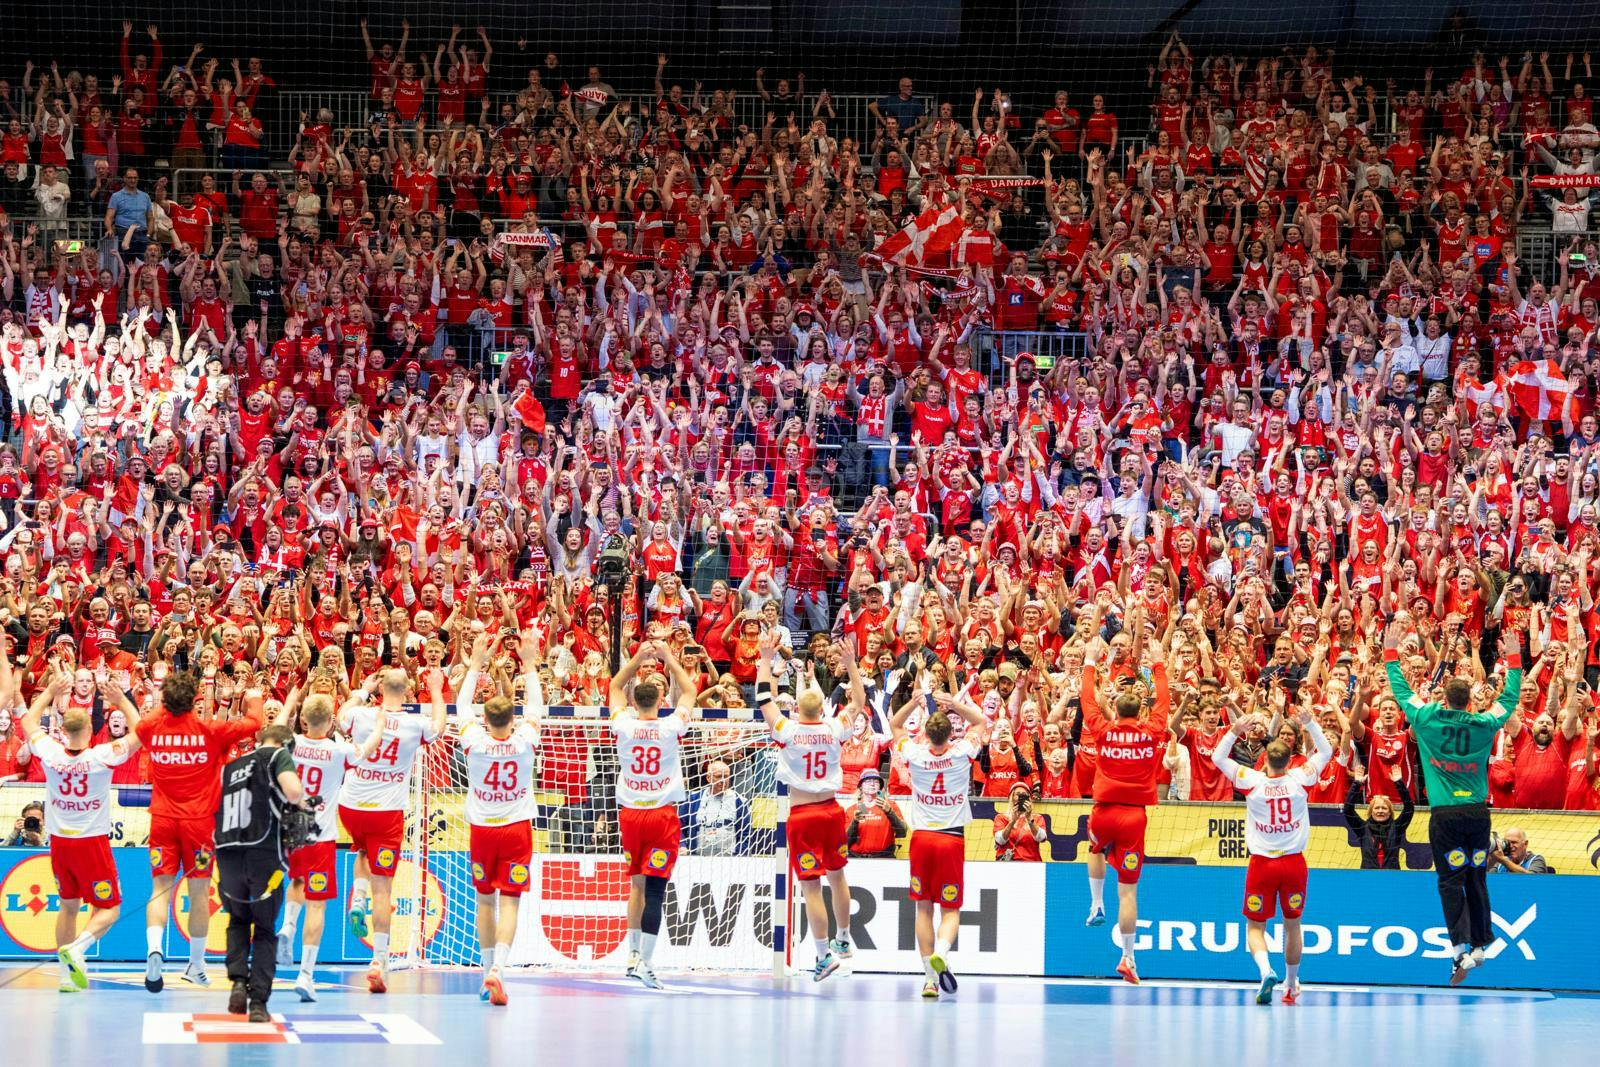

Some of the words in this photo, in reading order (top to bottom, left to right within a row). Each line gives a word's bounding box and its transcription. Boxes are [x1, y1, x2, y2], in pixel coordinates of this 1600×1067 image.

[505, 234, 551, 245] DANMAR
[560, 367, 569, 377] 10
[527, 468, 532, 478] 5
[460, 582, 530, 596] DNARK
[151, 735, 206, 747] DANMARK
[1440, 726, 1470, 756] 20
[150, 752, 208, 765] NORLYS
[293, 745, 332, 761] NDERSEN
[631, 745, 661, 776] 38
[1100, 745, 1154, 760] NORLYS
[802, 751, 827, 781] 15
[355, 768, 405, 783] NORLYS
[483, 760, 519, 791] 43
[931, 772, 947, 795] 4
[59, 771, 88, 797] 33
[473, 787, 527, 803] NORLYS
[917, 793, 964, 807] NORLYS
[52, 799, 101, 811] NORLYS
[1265, 797, 1292, 825] 19
[1208, 818, 1245, 838] PURE
[1255, 820, 1300, 834] NORLYS
[663, 882, 998, 952] WÜRTH
[1111, 920, 1453, 959] GRUNDFOS
